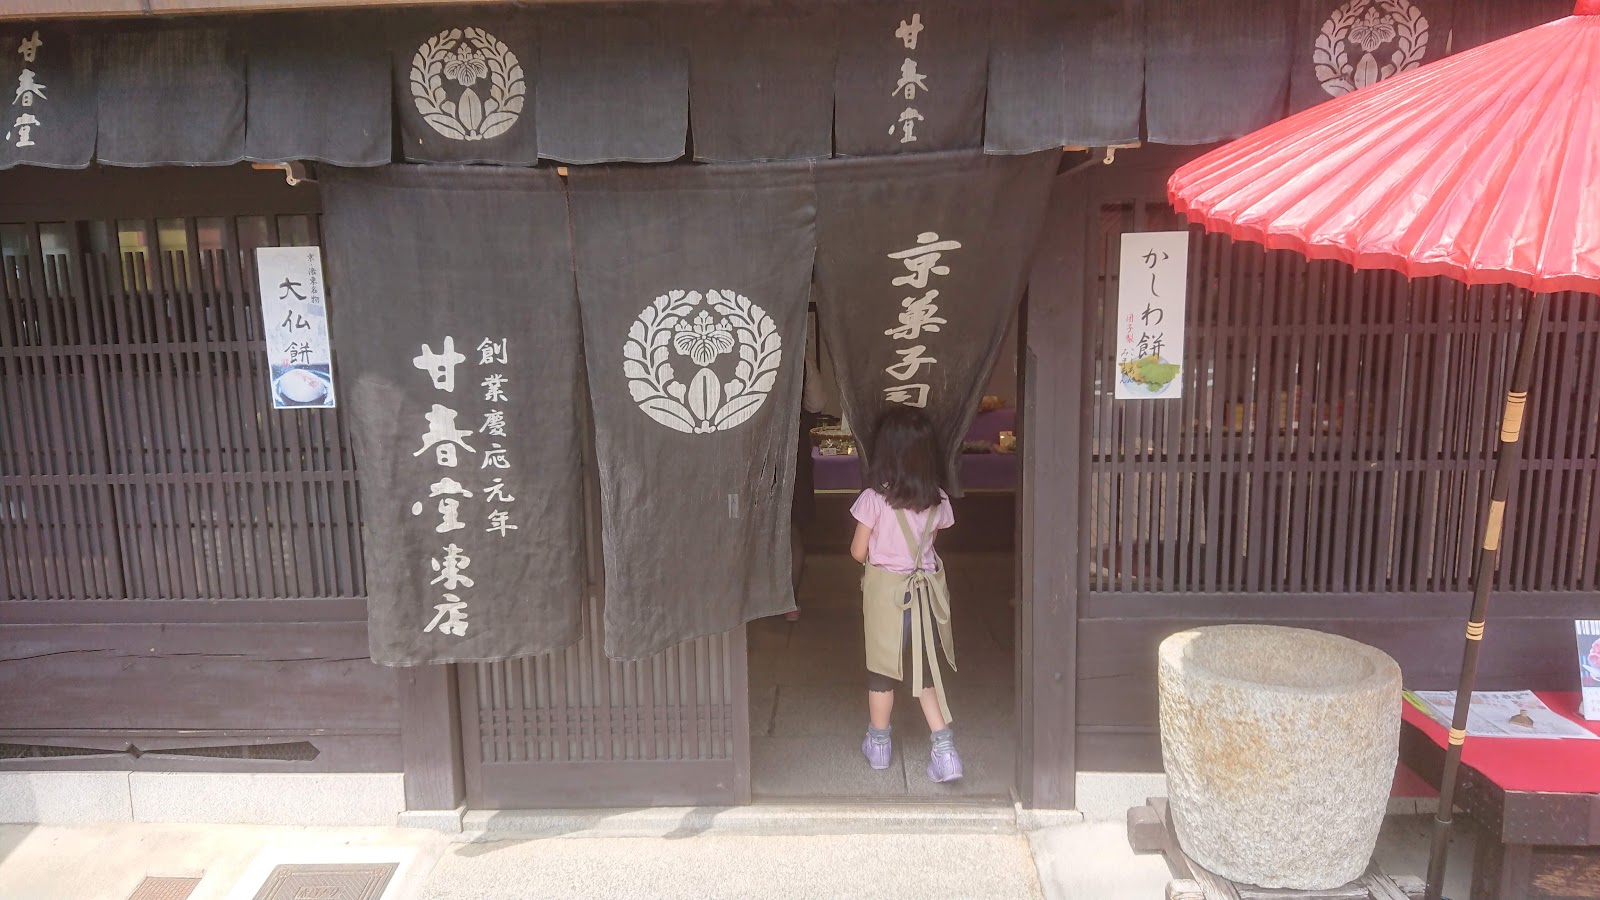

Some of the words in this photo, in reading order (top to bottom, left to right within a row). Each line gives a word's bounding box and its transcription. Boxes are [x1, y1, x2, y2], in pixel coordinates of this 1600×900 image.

[6, 31, 47, 147] 甘春堂
[888, 13, 928, 143] 甘春堂
[279, 277, 313, 365] 大仏餅
[884, 231, 961, 408] 京菓子司
[1136, 248, 1169, 359] かしわ餅
[412, 335, 476, 637] 甘春堂東店
[477, 337, 518, 537] 創業慶応元年
